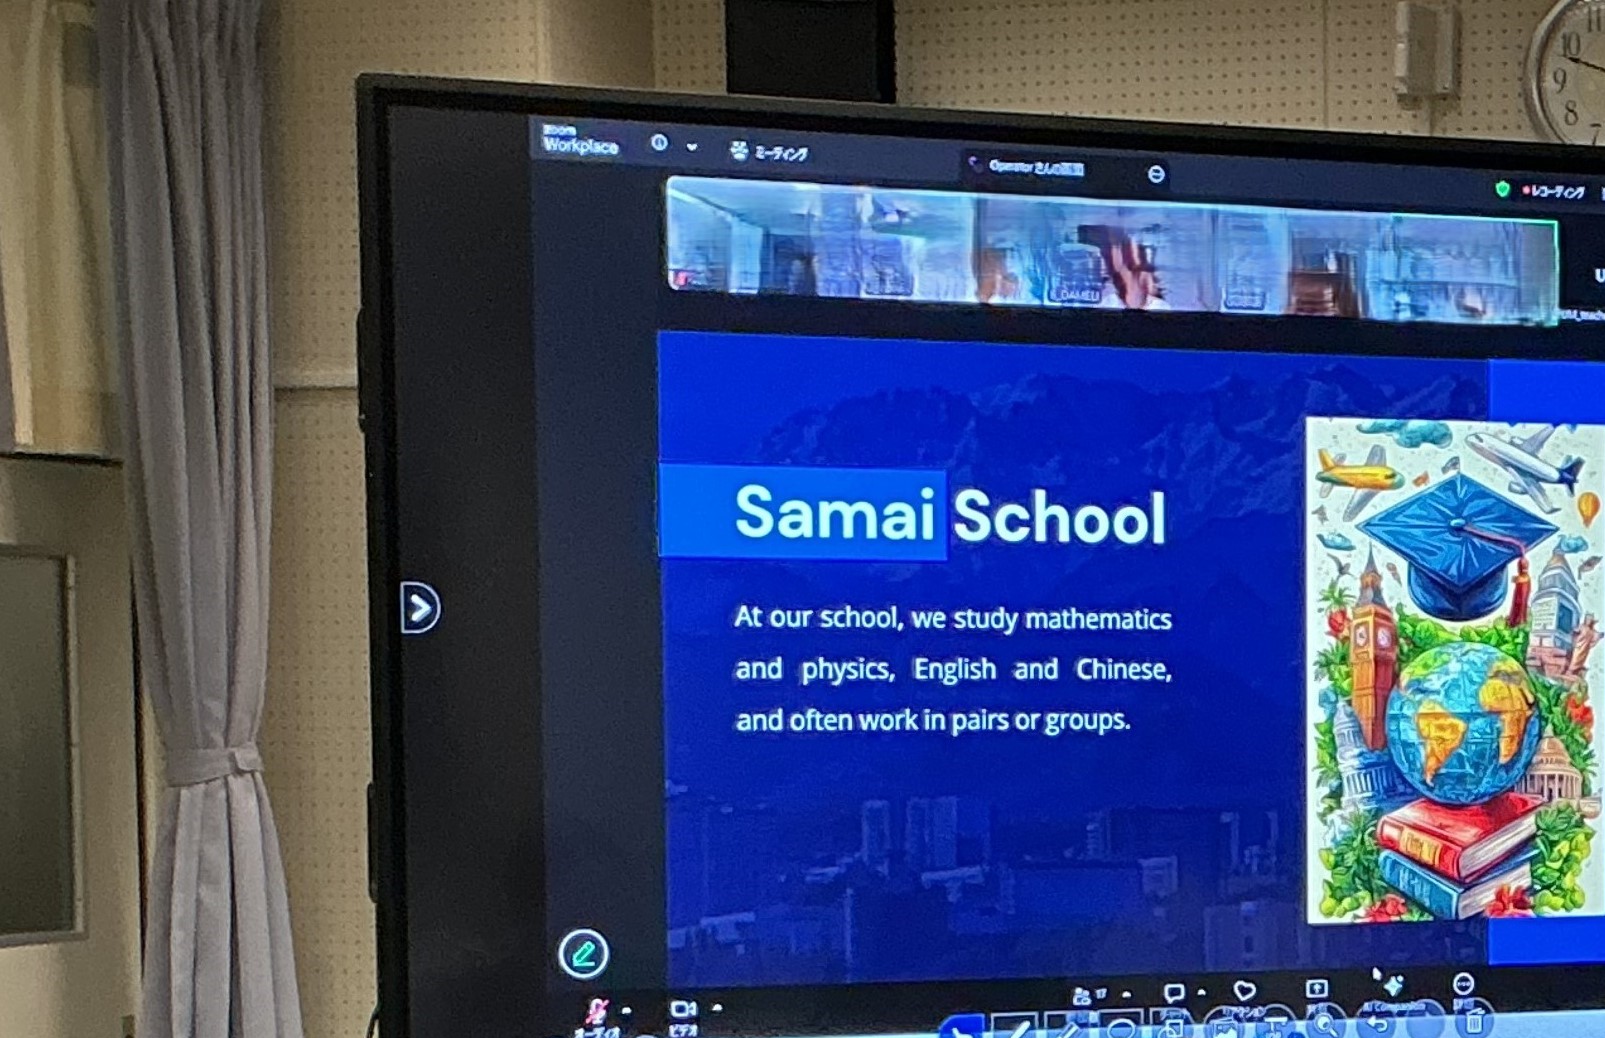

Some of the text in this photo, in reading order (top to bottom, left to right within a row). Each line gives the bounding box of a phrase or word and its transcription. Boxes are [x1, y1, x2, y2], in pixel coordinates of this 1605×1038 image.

[1560, 31, 1581, 57] 10
[1553, 68, 1567, 94] 9
[1564, 100, 1579, 125] 8
[543, 136, 620, 156] Workplace
[736, 484, 1166, 545] Samai School
[734, 604, 1173, 636] At our school, we study mathematics
[735, 655, 1173, 687] and physics, English and Chinese,
[735, 707, 1131, 737] and often work in pairs or groups.
